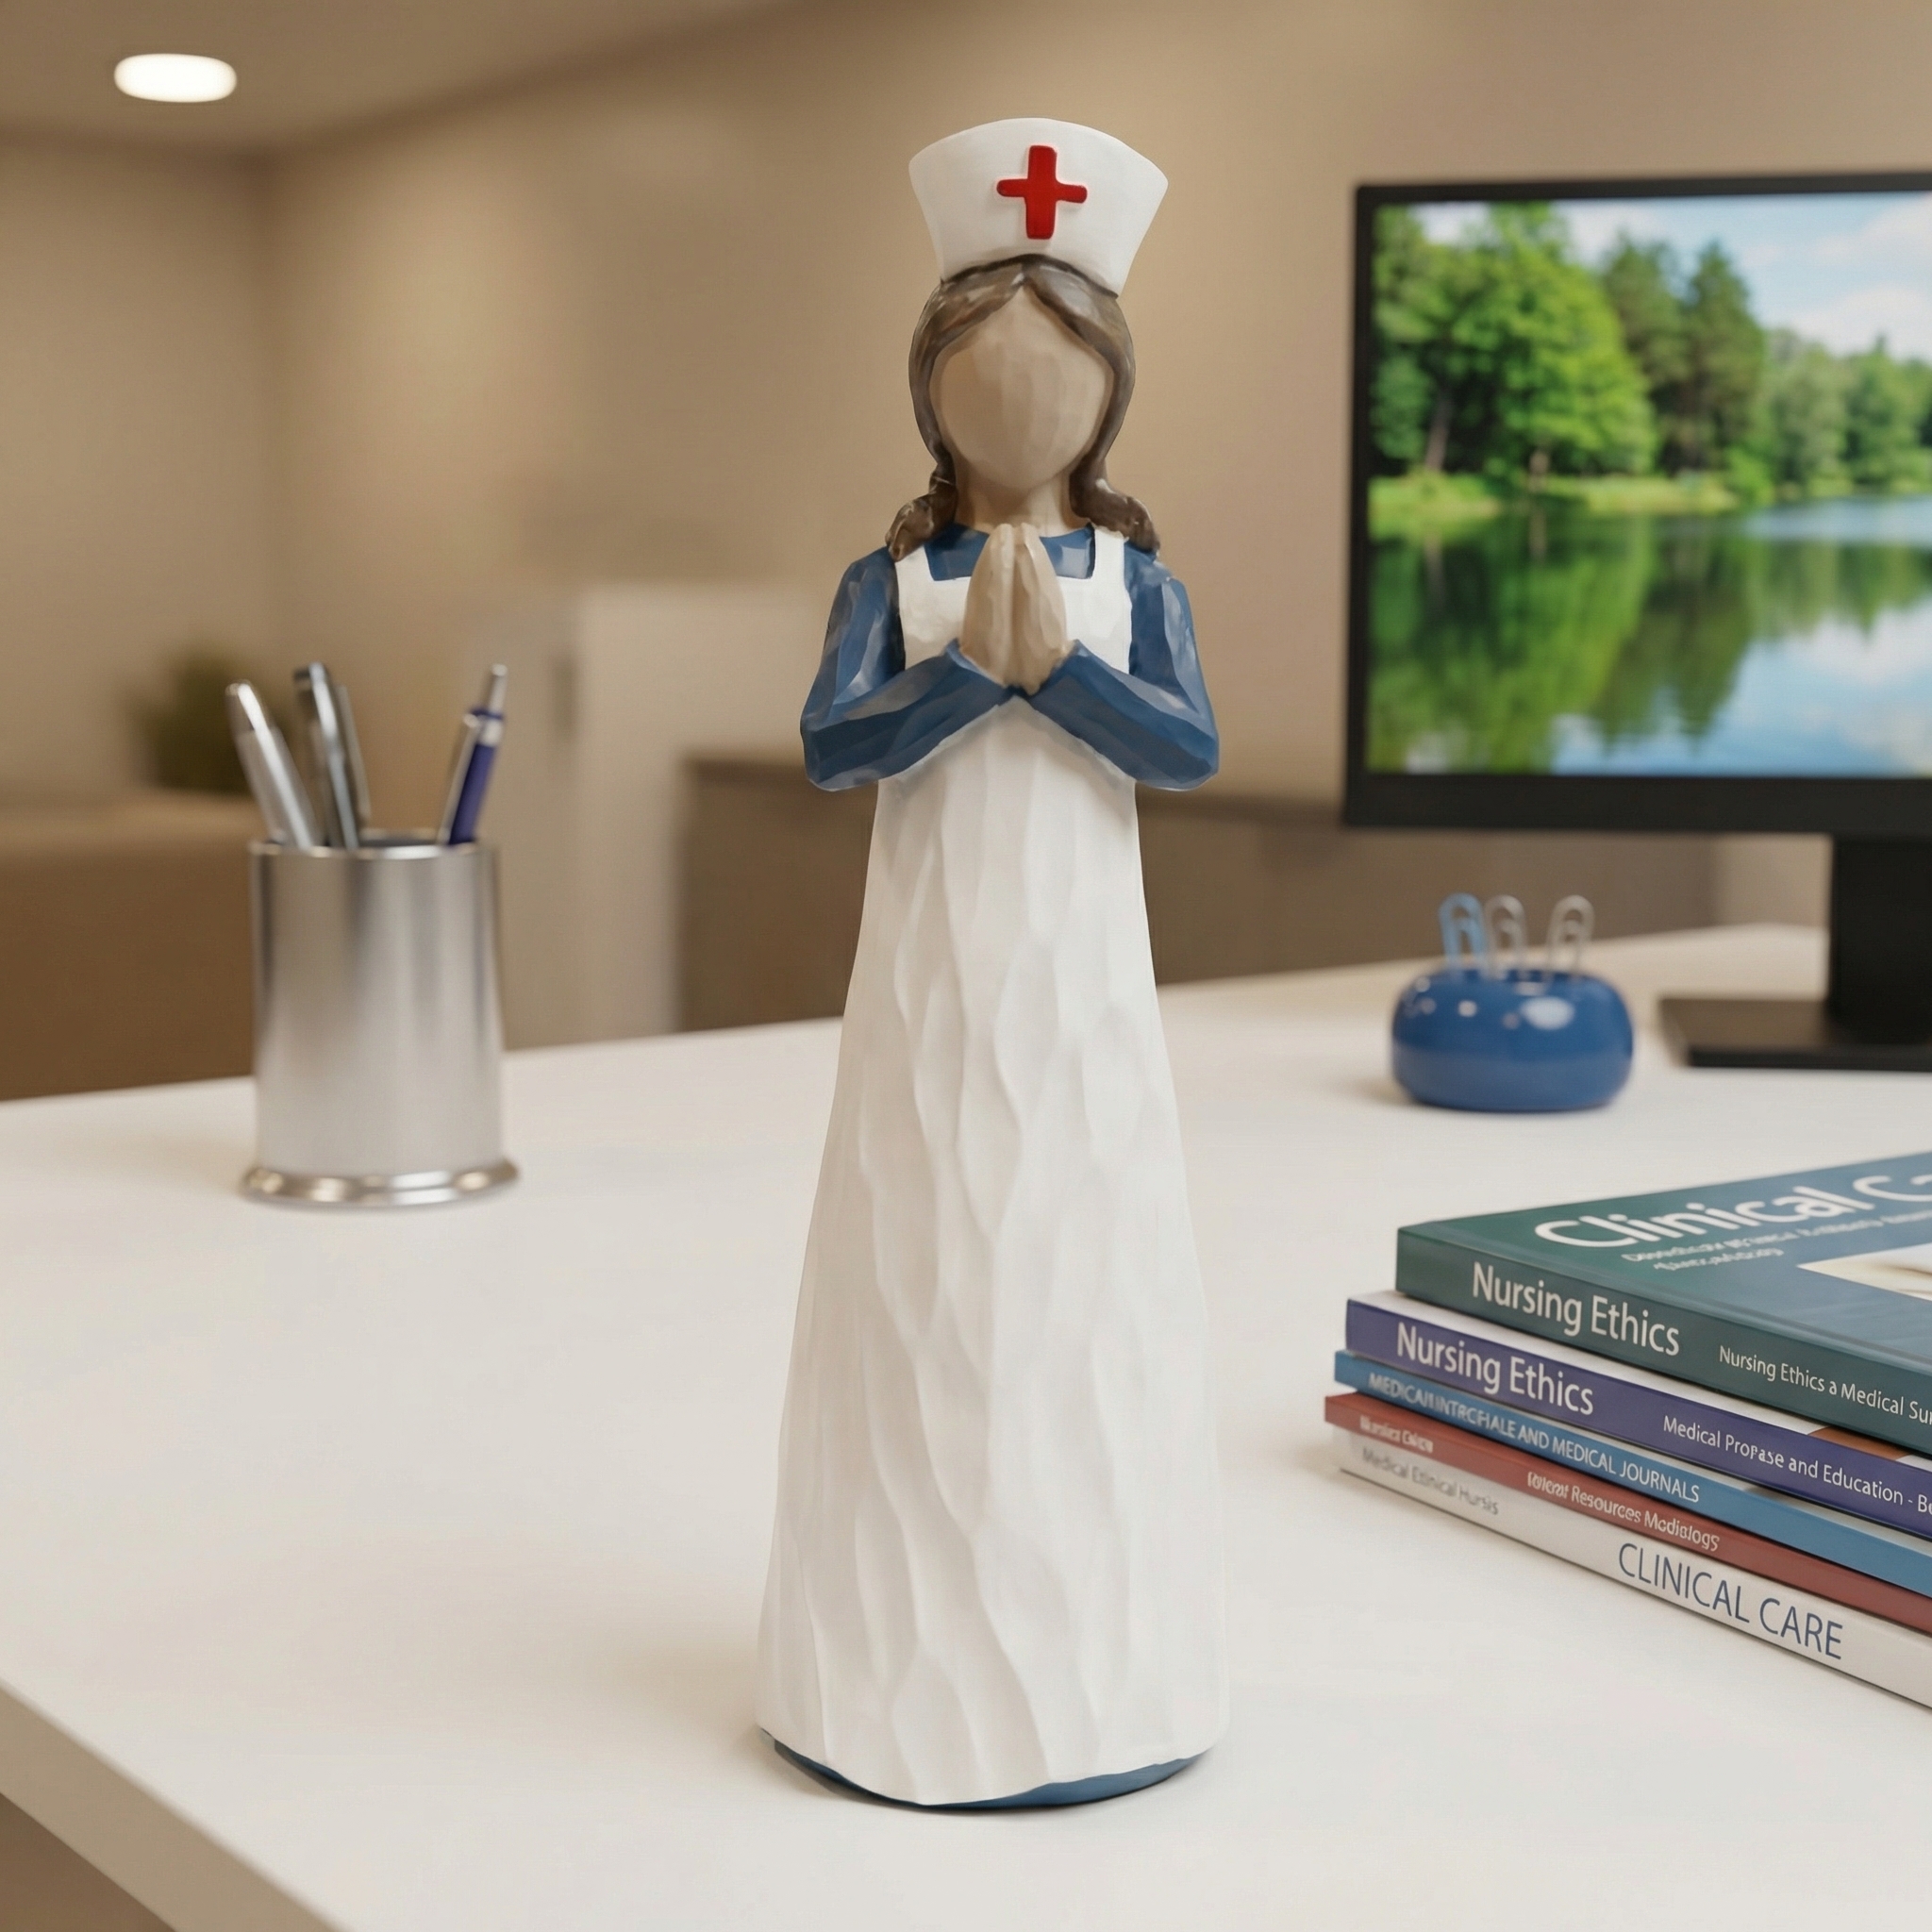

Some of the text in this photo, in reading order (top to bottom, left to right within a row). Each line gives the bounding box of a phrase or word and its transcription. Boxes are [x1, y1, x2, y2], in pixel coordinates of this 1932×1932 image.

[1535, 1186, 1875, 1248] Clinical
[1852, 1174, 1932, 1202] C
[1473, 1261, 1582, 1337] Nursing
[1591, 1294, 1680, 1357] Ethics
[1719, 1345, 1776, 1382] Nursing
[1780, 1363, 1825, 1392] Ethics
[1828, 1380, 1838, 1395] a
[1840, 1383, 1905, 1415] Medical
[1397, 1322, 1501, 1395] Nursing
[1509, 1356, 1594, 1415] Ethics
[1663, 1415, 1721, 1448] Medical
[1788, 1457, 1819, 1479] and
[1823, 1465, 1904, 1506] Education
[1517, 1424, 1550, 1449] AND
[1552, 1436, 1617, 1475] MEDICAL
[1619, 1459, 1700, 1504] JOURNALS
[1571, 1485, 1641, 1524] Resources
[1618, 1542, 1843, 1660] CLINICAL CARE
